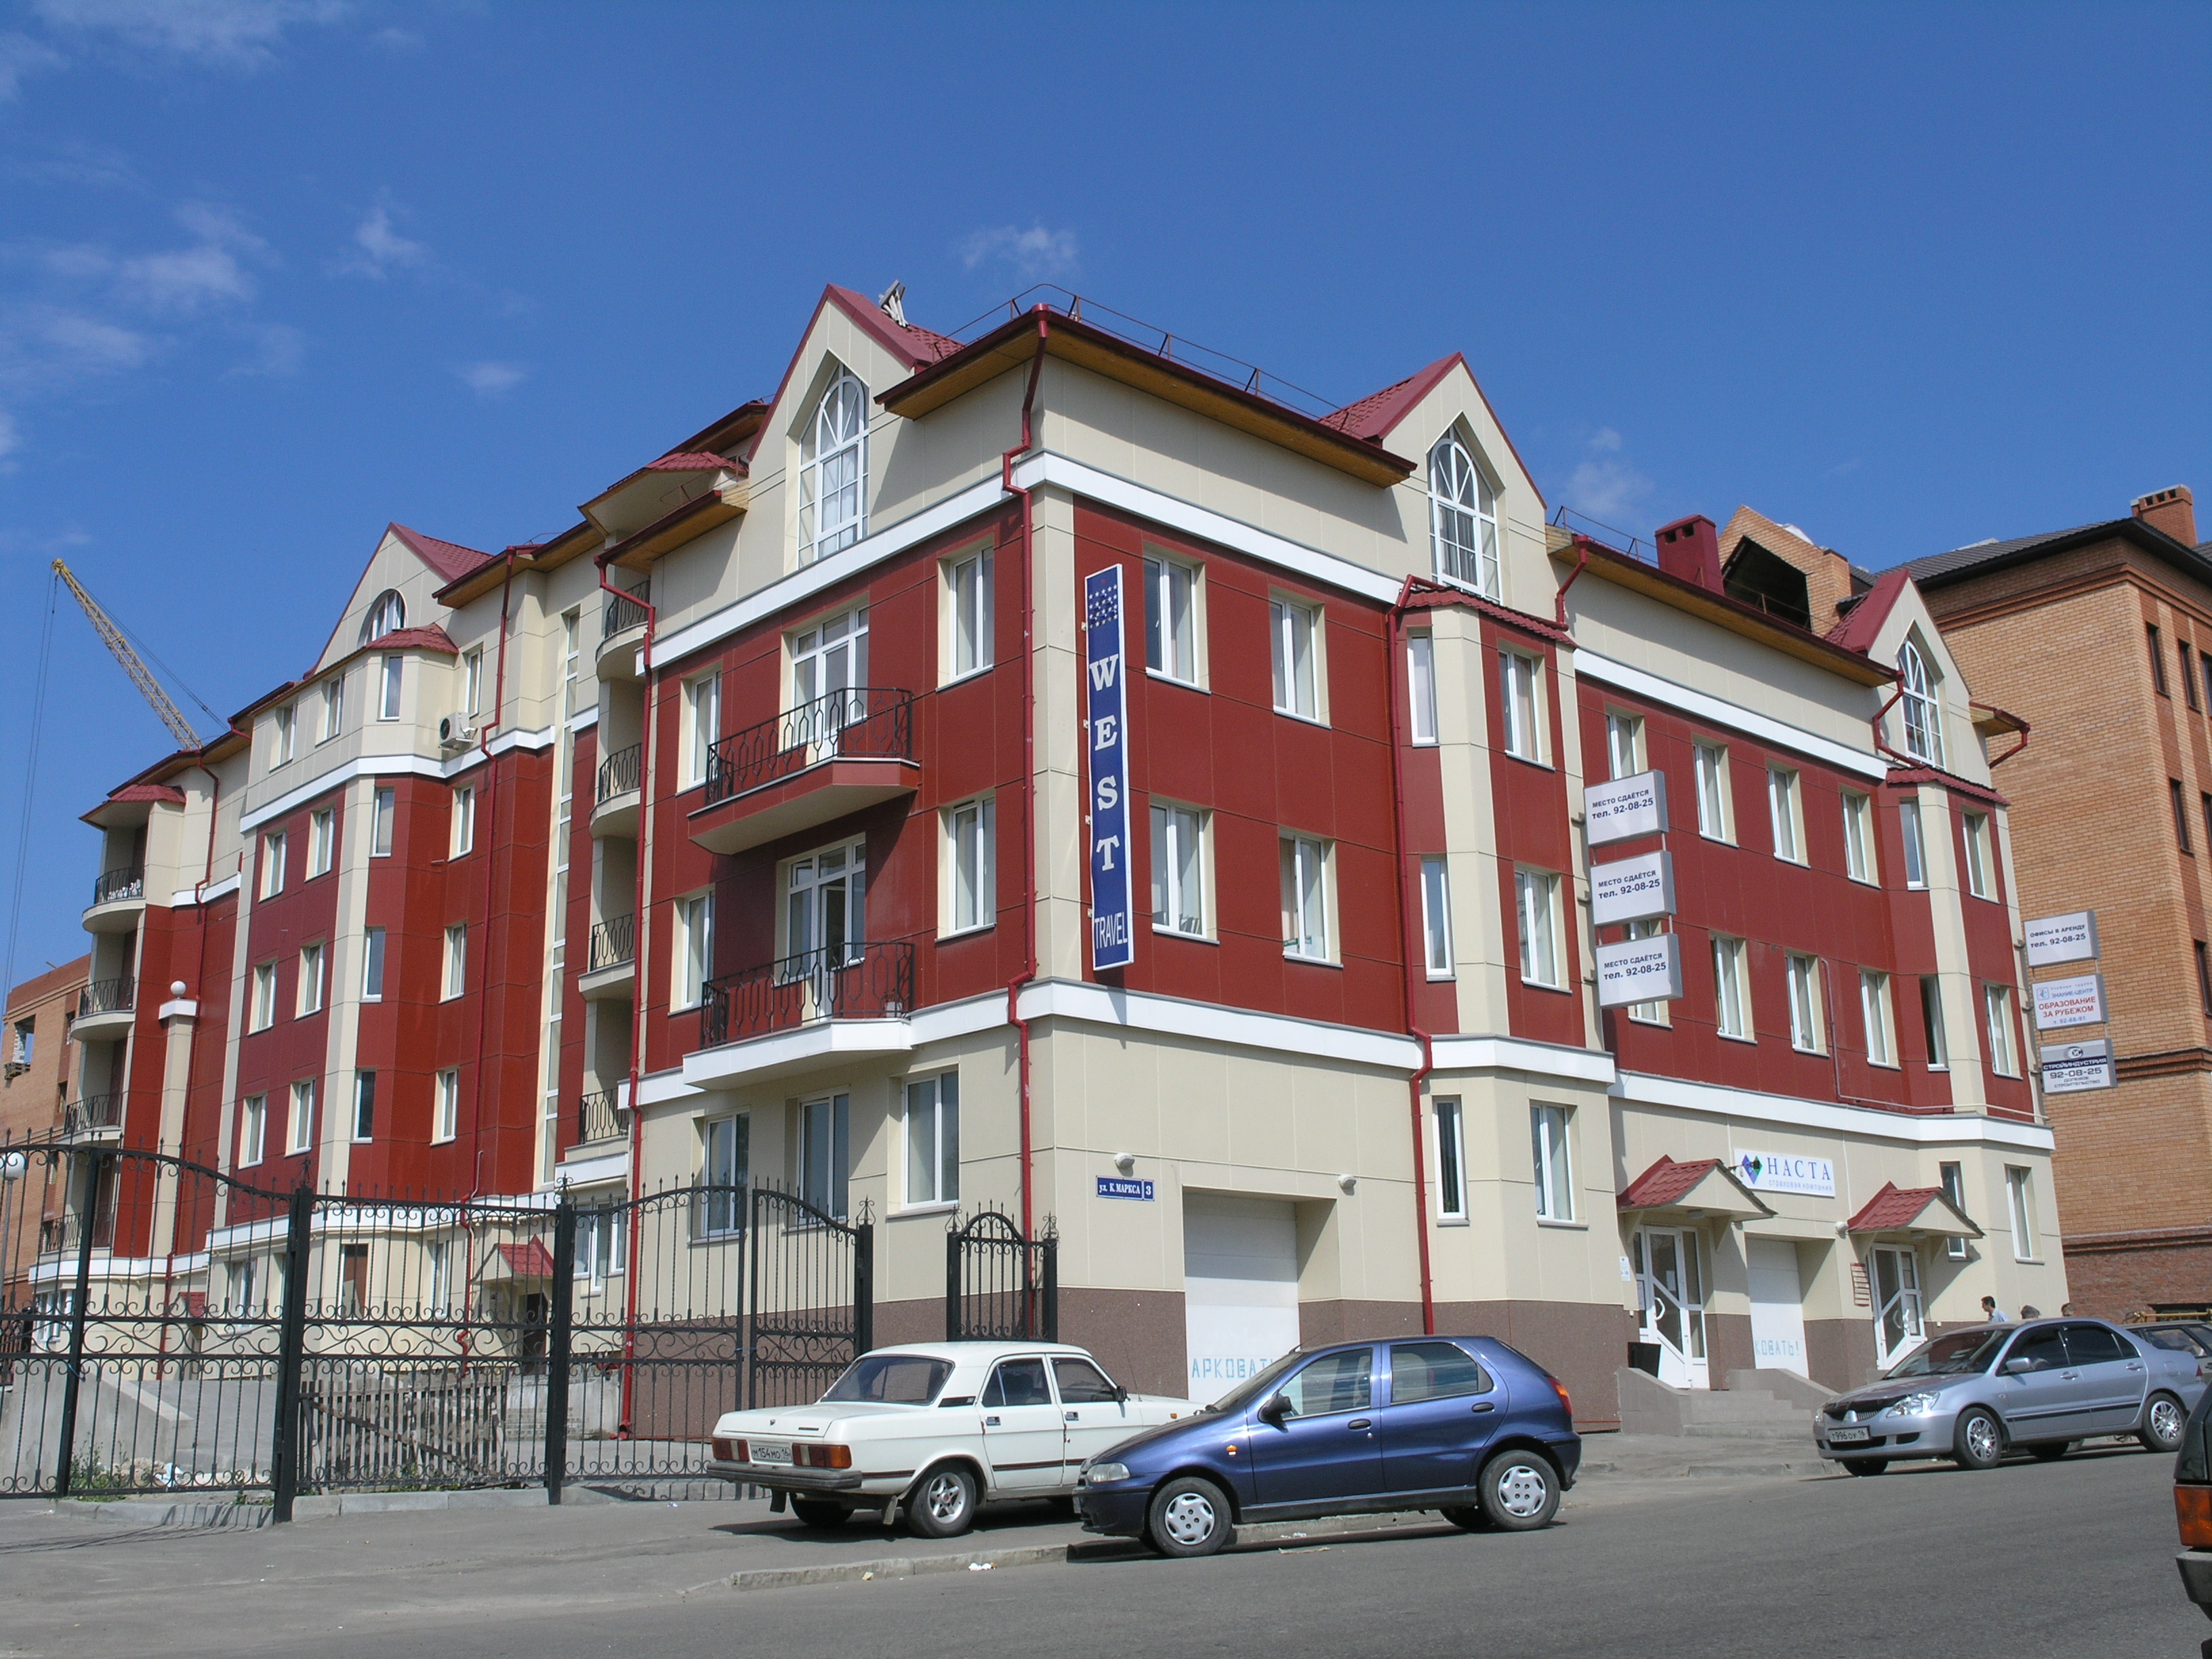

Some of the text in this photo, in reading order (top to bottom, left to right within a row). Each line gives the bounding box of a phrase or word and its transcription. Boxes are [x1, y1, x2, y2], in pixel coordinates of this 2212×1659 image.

[1090, 653, 1120, 872] WEST
[1592, 798, 1654, 819] тел. 92-08-25
[1593, 798, 1616, 808] МЕСТО
[1598, 878, 1622, 888] МЕСТО
[1599, 878, 1660, 899] тел. 92-08-25
[1094, 912, 1128, 949] TRAVEL
[2030, 930, 2053, 938] ОФИСЫ
[2061, 924, 2085, 933] АРЕНДУ
[2049, 933, 2086, 945] 92-08-25
[1604, 959, 1629, 968] МЕСТО
[1603, 962, 1666, 980] тел. 92-08-25
[2039, 996, 2096, 1010] ОБРАЗОВАНИЕ
[2055, 1005, 2094, 1017] РУБЕЖОМ
[2043, 1058, 2107, 1070] СТРОЙИНДУСТРИЯ
[2050, 1067, 2102, 1079] 92-08-25
[1767, 1157, 1831, 1181] НАСТА
[1115, 1183, 1141, 1194] МАРКСА
[1145, 1185, 1151, 1195] 3
